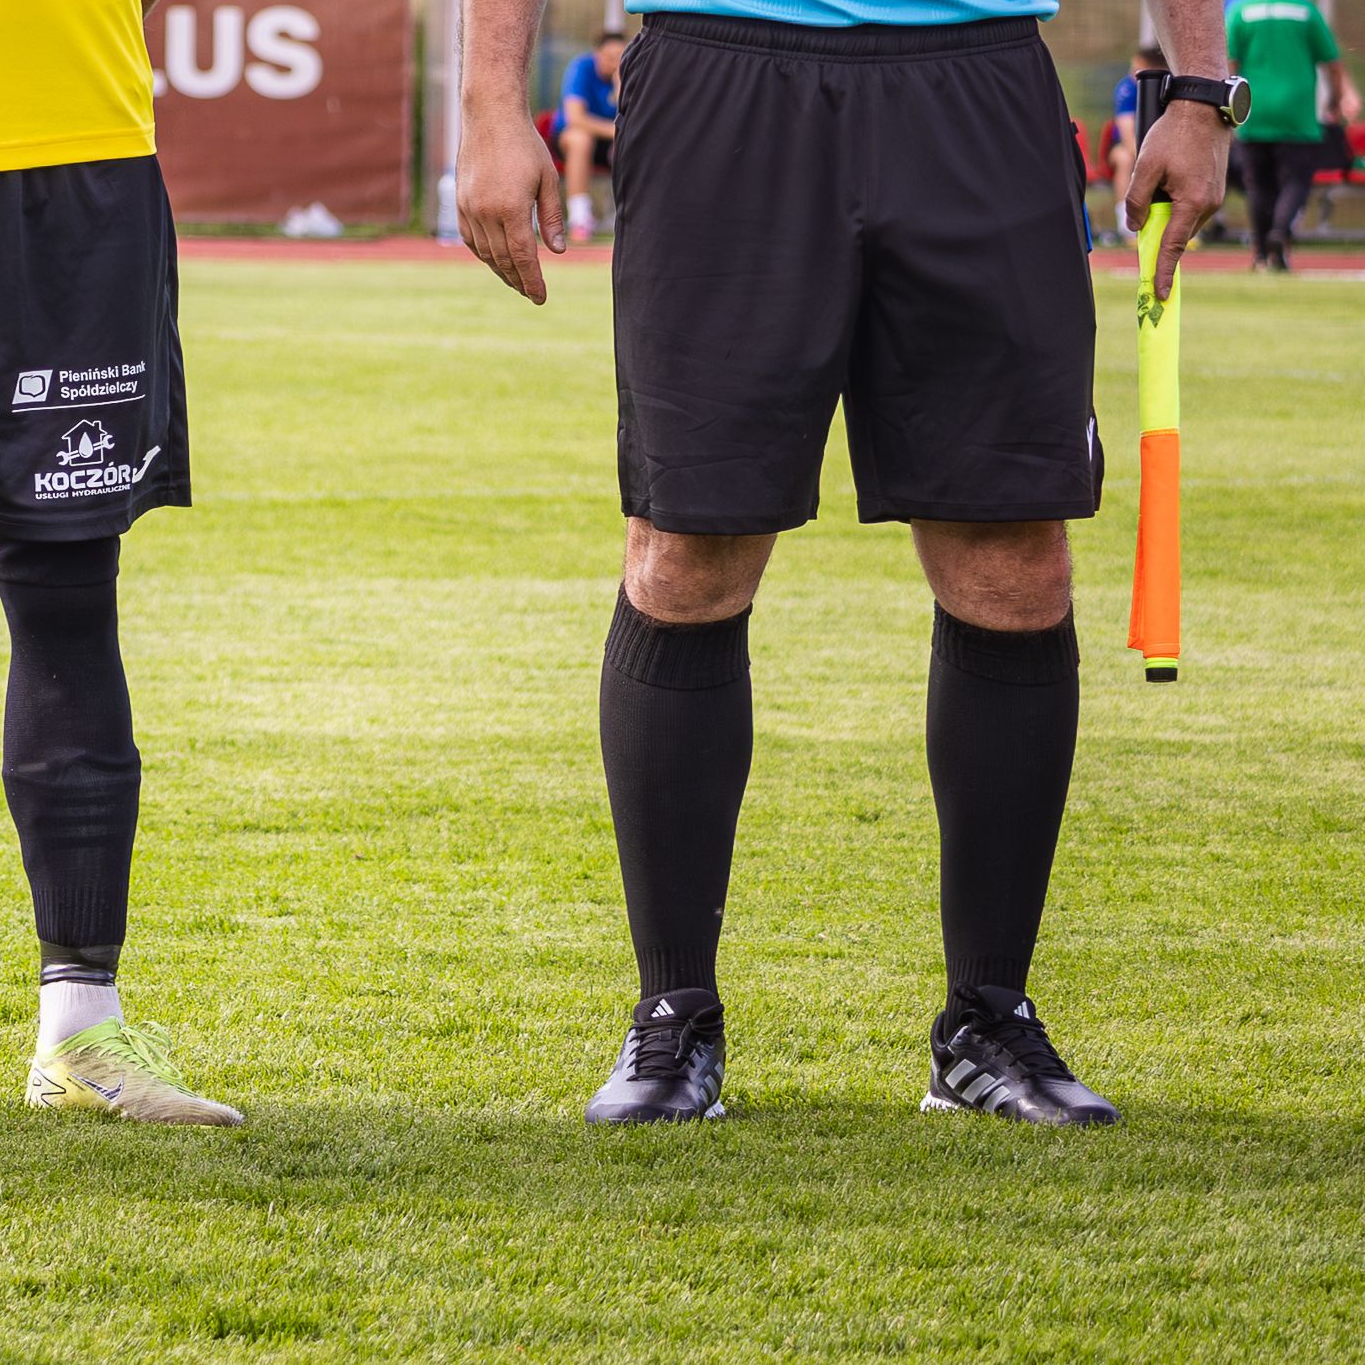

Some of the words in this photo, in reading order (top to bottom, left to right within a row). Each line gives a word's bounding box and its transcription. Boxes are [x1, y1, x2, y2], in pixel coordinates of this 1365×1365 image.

[59, 366, 119, 383] Pieniński
[121, 360, 146, 377] Bank
[60, 380, 138, 401] Spółdzielczy
[34, 462, 131, 492] KOCZÓR
[35, 490, 69, 500] USŁUGI
[72, 483, 131, 498] HYDRAULICZNE
